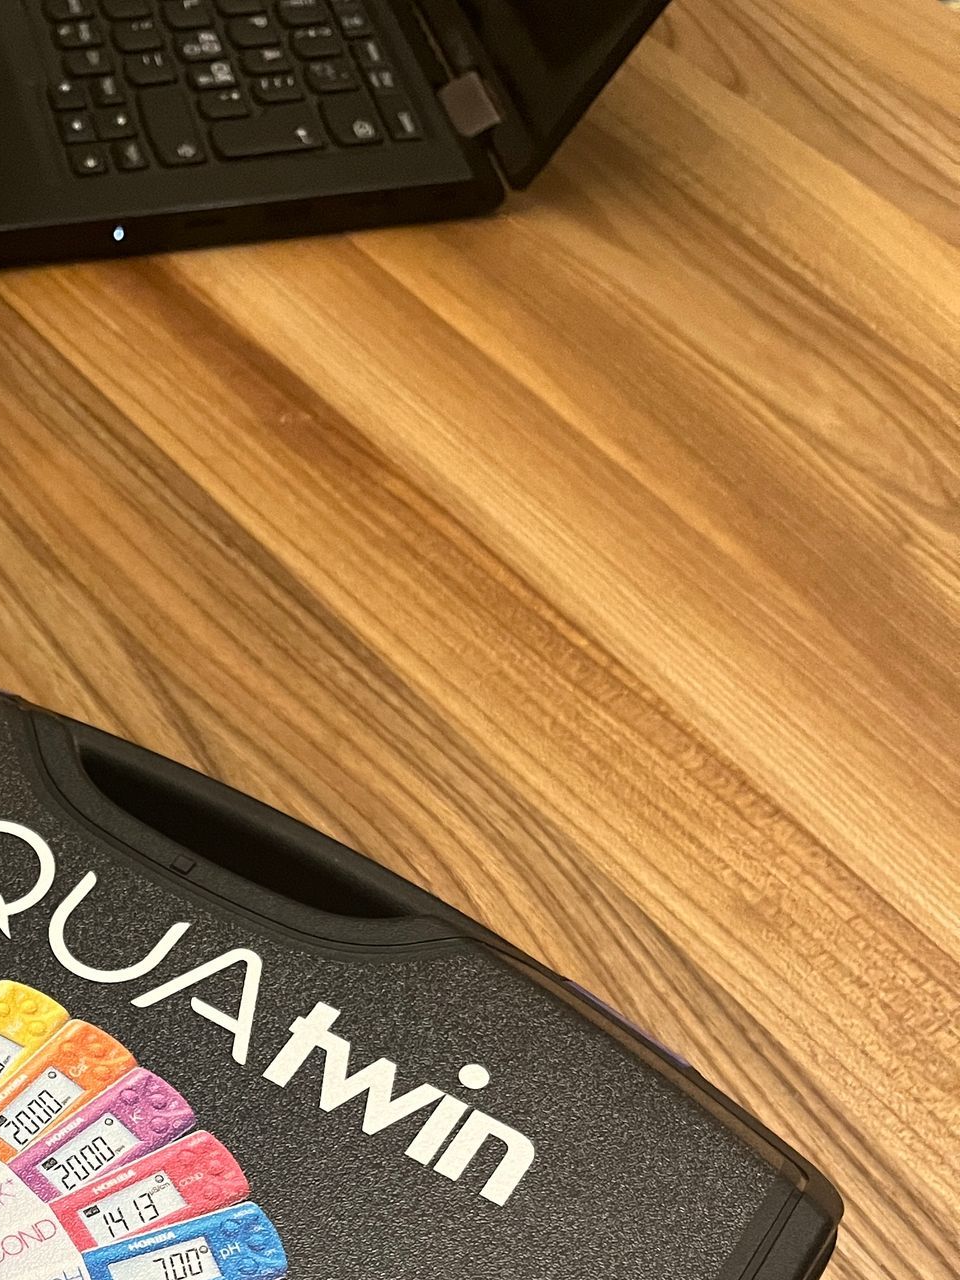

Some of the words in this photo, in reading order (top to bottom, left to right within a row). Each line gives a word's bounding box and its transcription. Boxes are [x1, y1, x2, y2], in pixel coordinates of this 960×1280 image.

[4, 1089, 63, 1145] 2000
[53, 1136, 115, 1191] 2000
[91, 1170, 136, 1195] HORIBA
[128, 1231, 176, 1251] HORIBA
[219, 1242, 241, 1259] pH
